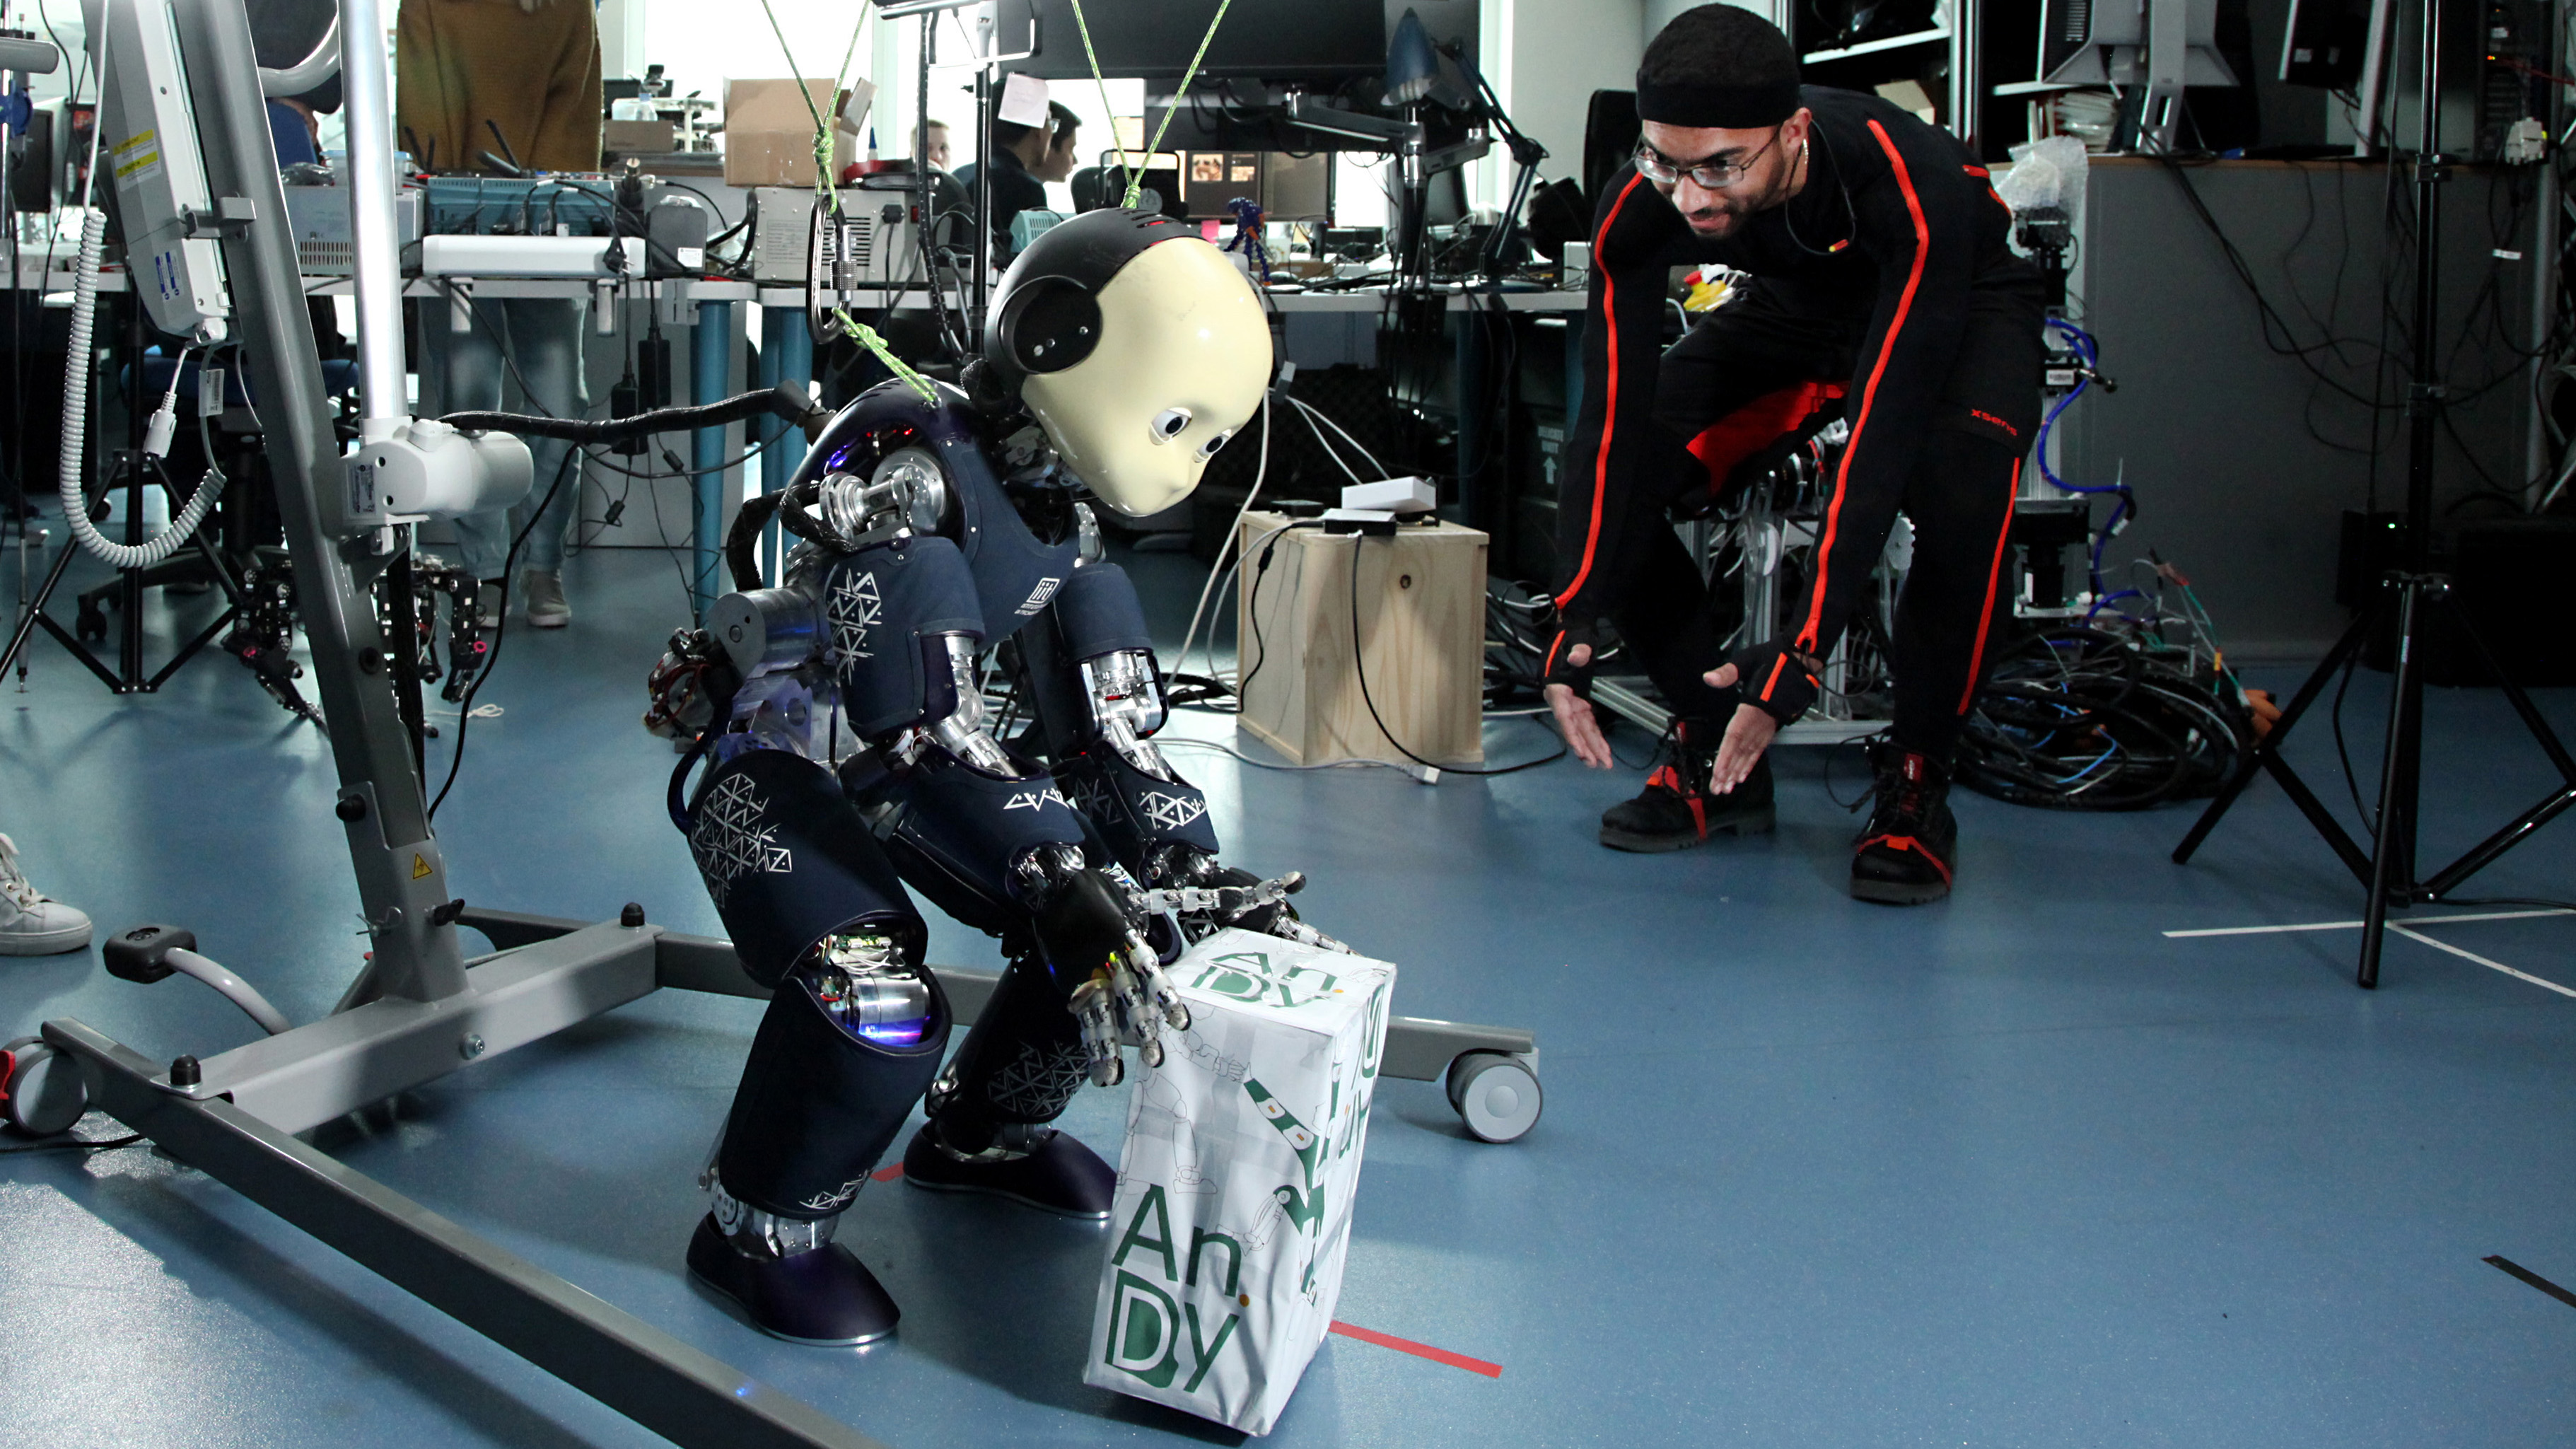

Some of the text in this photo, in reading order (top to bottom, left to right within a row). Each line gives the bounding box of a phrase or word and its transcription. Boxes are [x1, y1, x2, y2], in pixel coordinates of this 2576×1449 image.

[1971, 409, 2017, 436] xsens
[1032, 581, 1054, 600] iit
[1105, 1268, 1240, 1394] Dy
